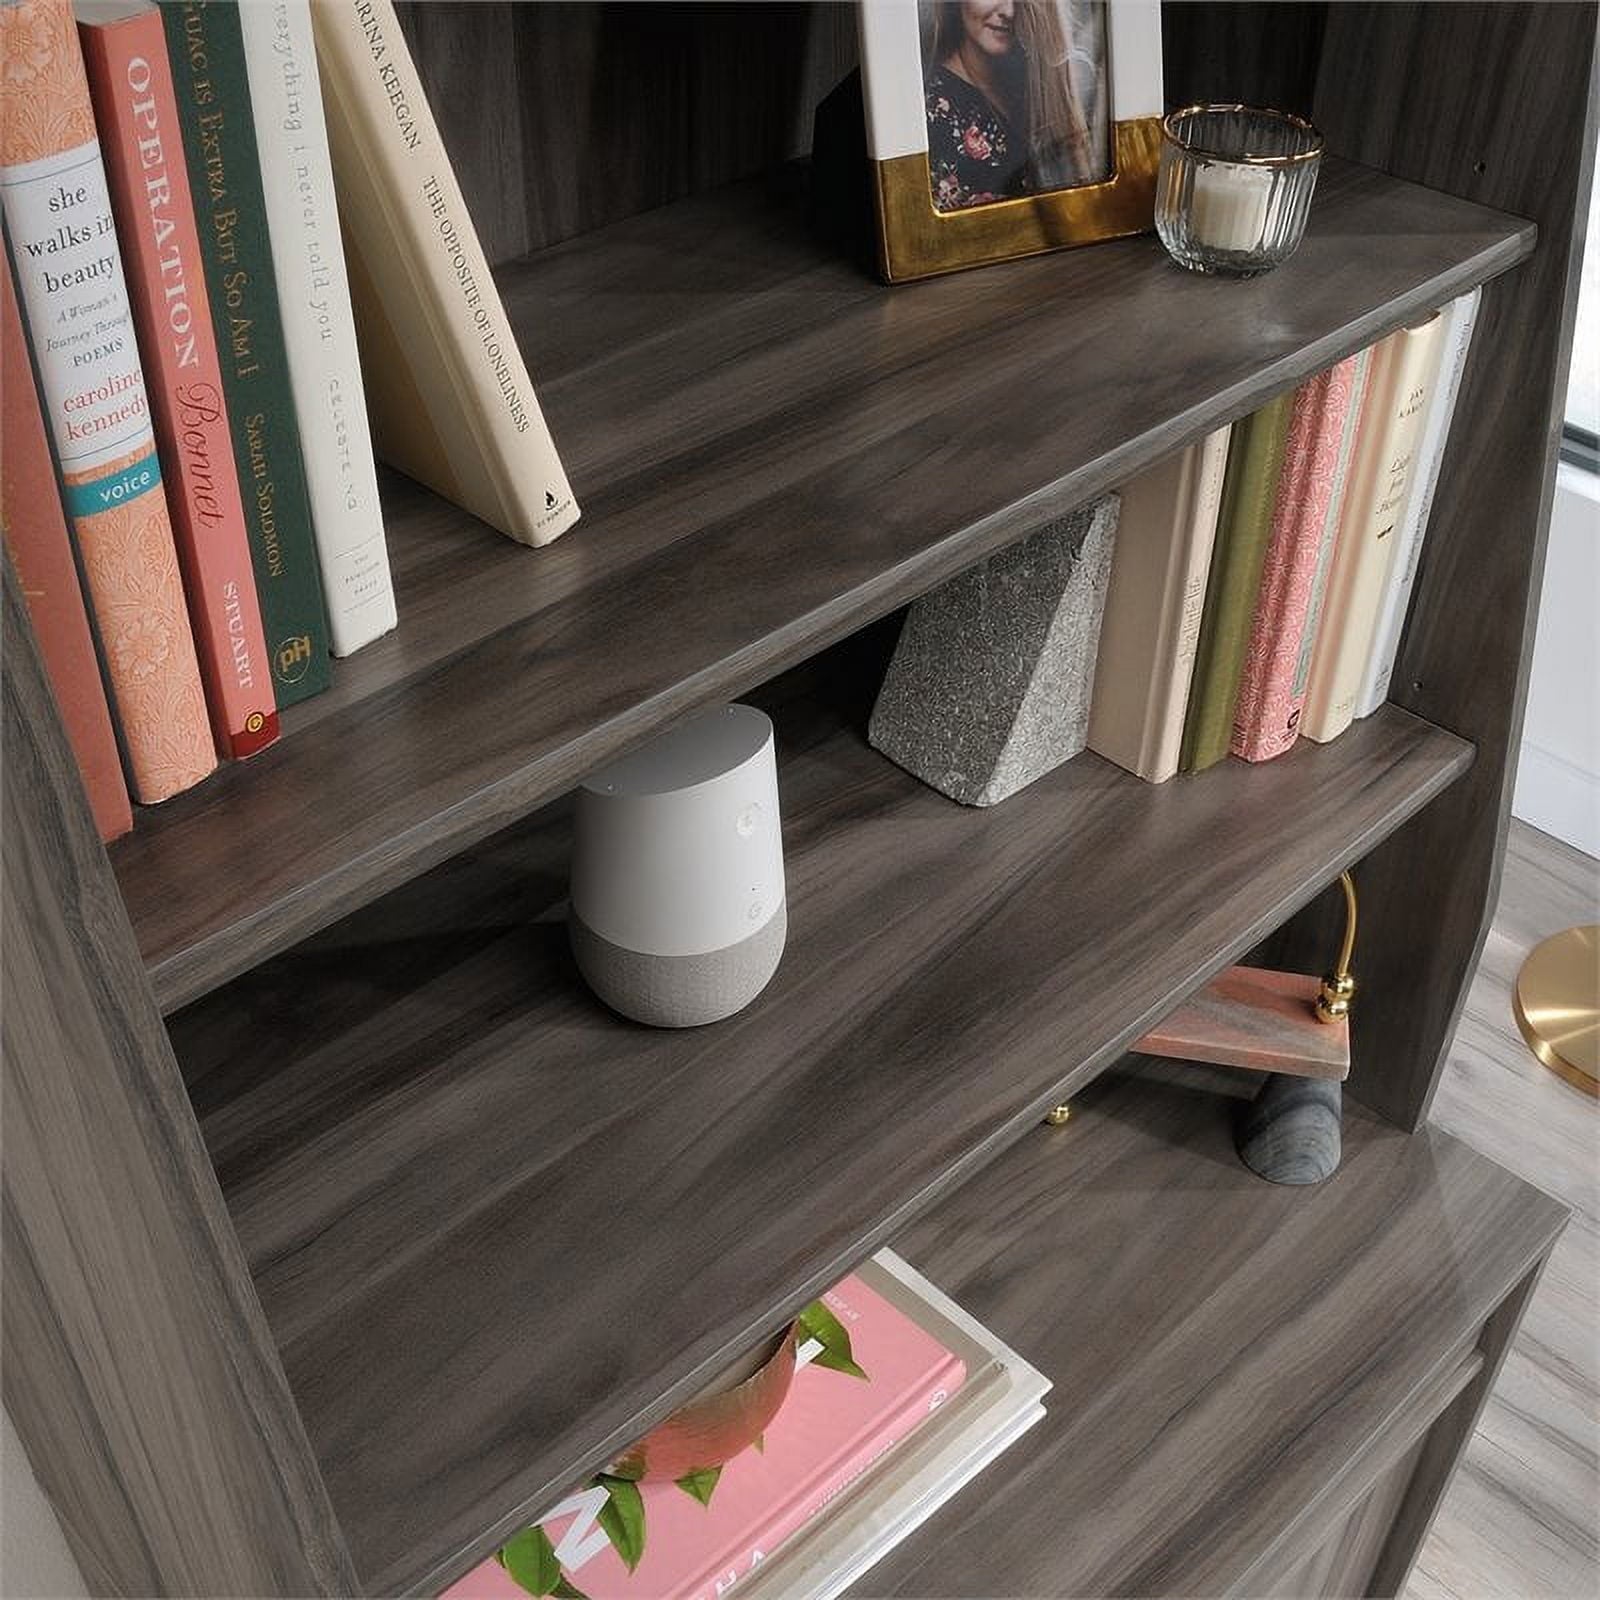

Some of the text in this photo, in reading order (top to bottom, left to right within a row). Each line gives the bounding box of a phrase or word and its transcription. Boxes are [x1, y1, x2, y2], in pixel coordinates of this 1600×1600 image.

[380, 63, 421, 149] KEEGAN
[49, 187, 87, 212] she
[128, 57, 199, 368] OPERATION
[297, 165, 316, 229] never
[23, 214, 113, 257] walks in
[43, 255, 115, 293] beauty
[307, 241, 329, 289] told
[310, 300, 332, 340] you
[422, 175, 530, 434] THE OPPOSITE OF LONELINESS
[73, 338, 123, 367] POEMS
[65, 394, 146, 441] kennedy
[176, 383, 224, 528] Bonnet
[100, 471, 150, 502] voice
[245, 413, 286, 577] SARAH SOLOMON
[223, 580, 254, 689] STUART
